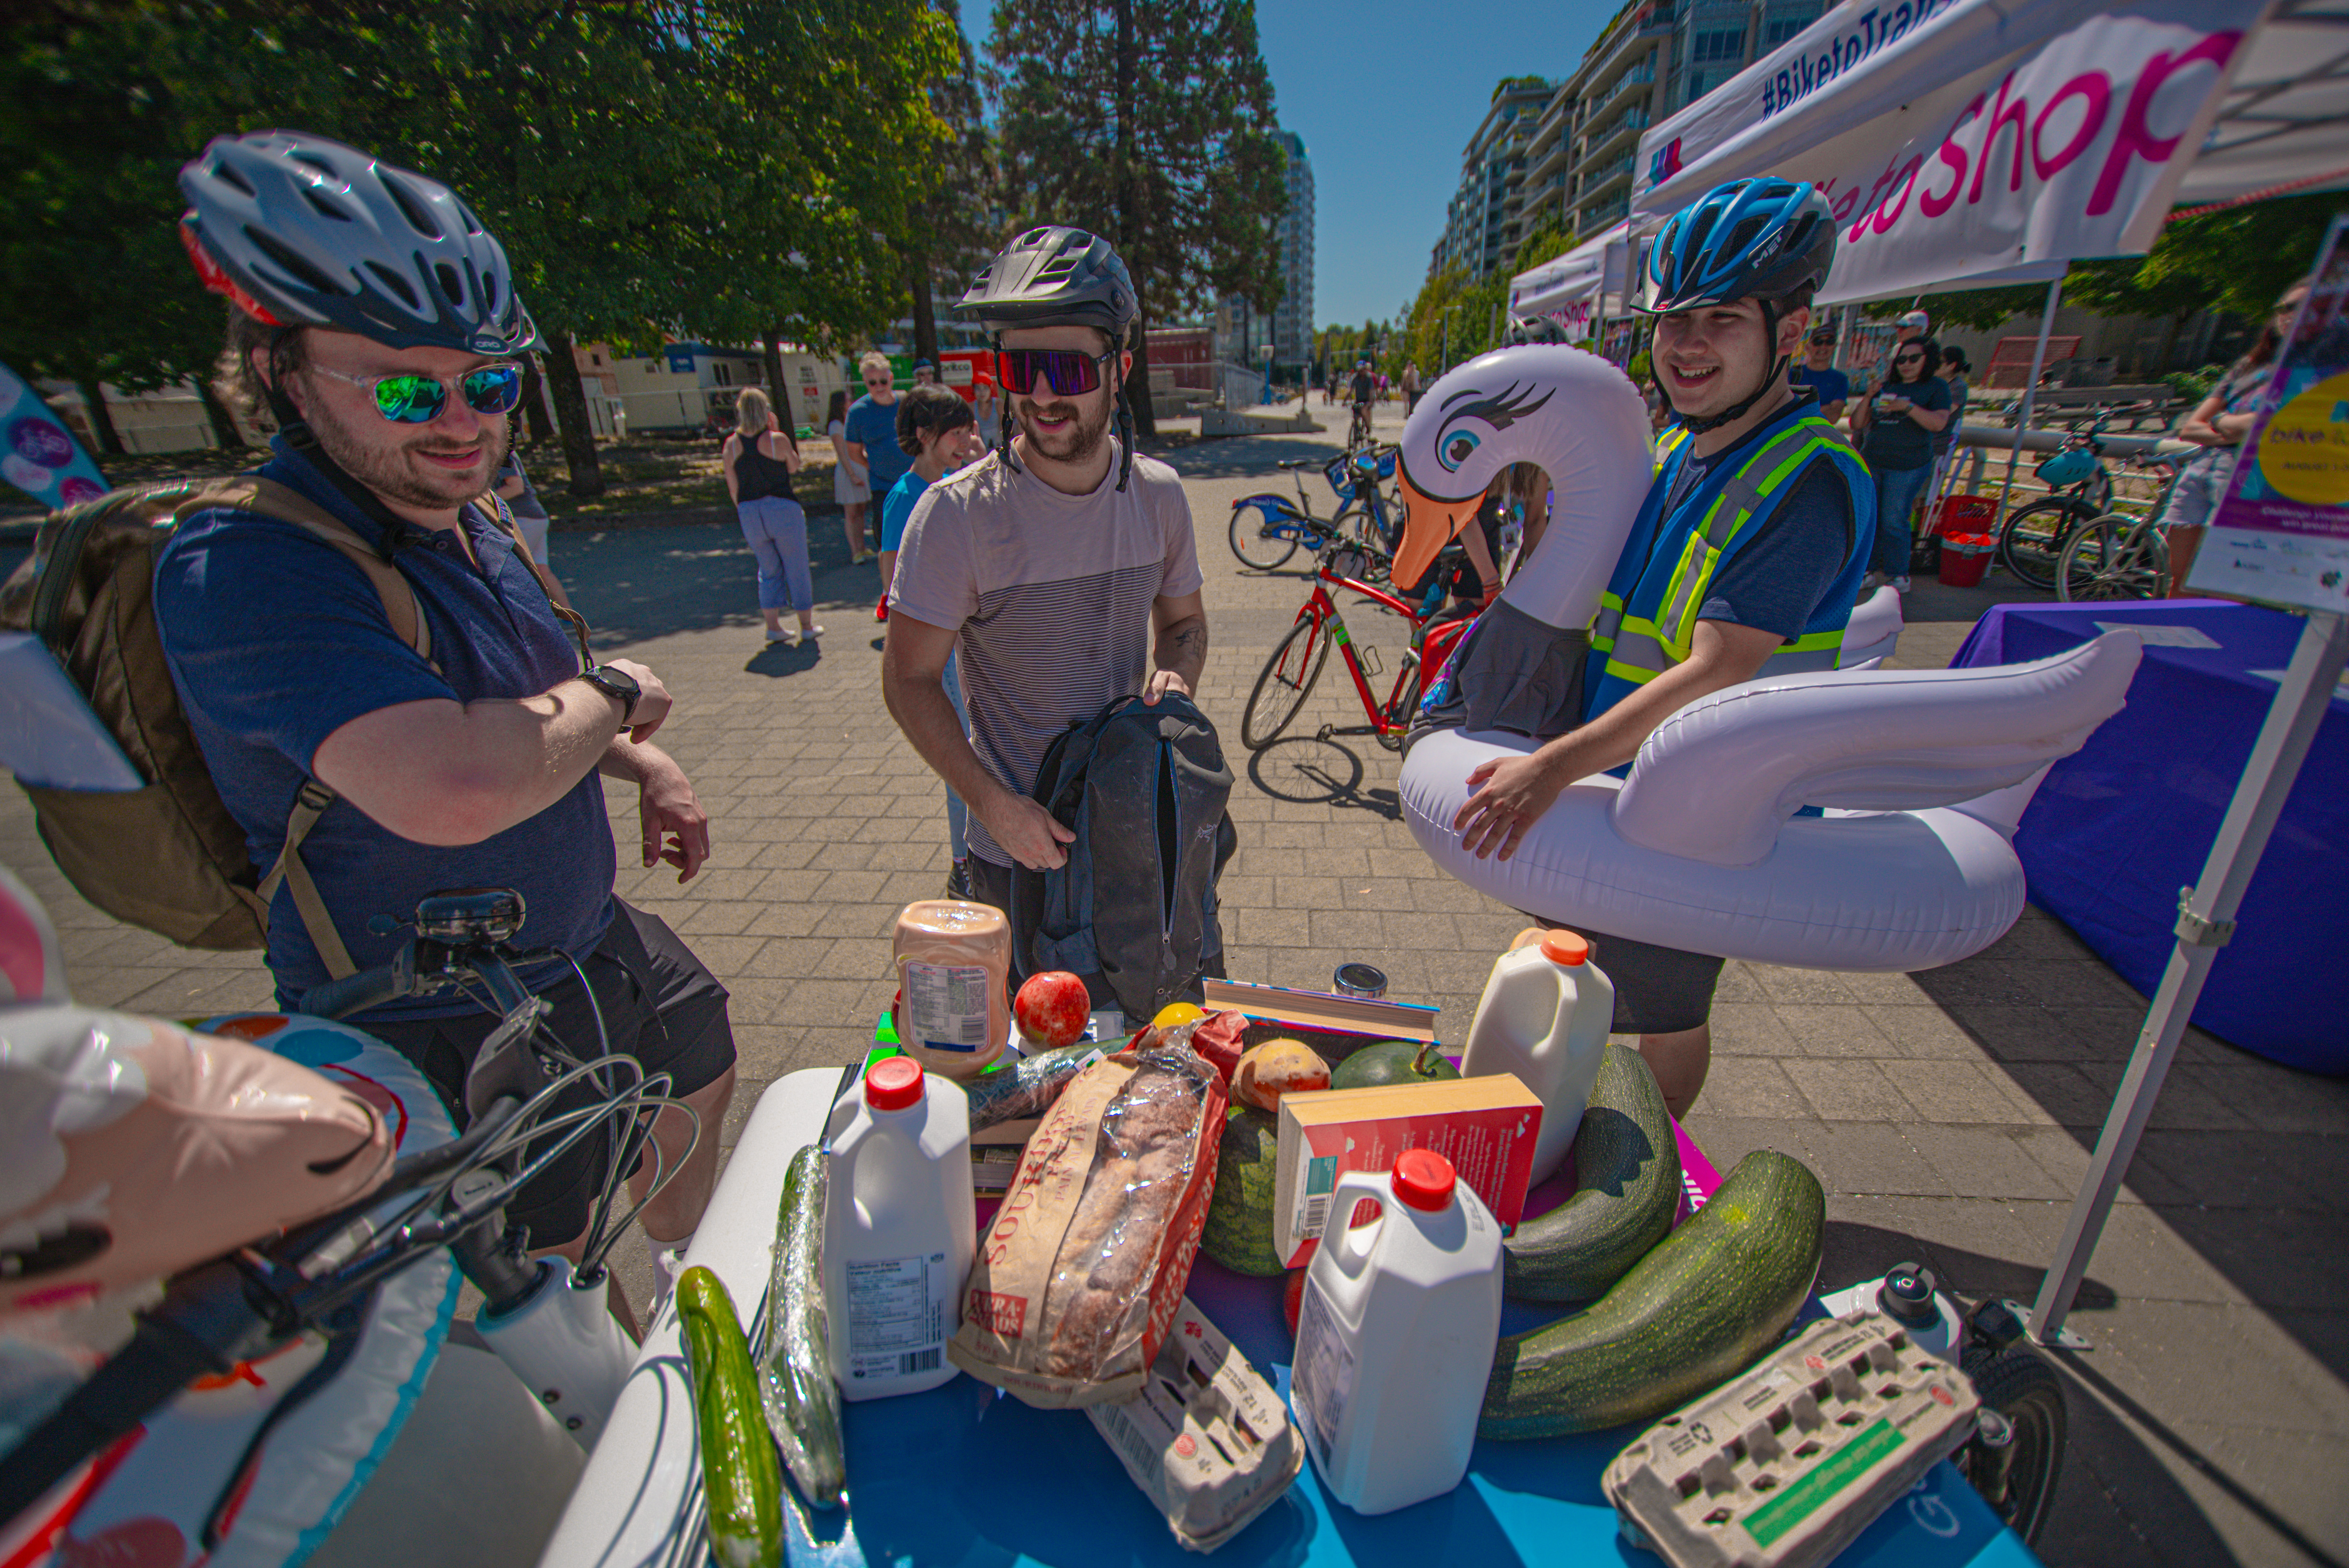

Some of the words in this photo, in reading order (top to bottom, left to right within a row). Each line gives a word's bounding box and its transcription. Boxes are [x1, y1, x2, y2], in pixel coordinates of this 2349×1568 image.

[1752, 230, 1783, 269] MET
[1074, 1094, 1099, 1142] LEVAIN
[1068, 1145, 1084, 1164] AU
[1054, 1165, 1075, 1203] PAIN
[1242, 1394, 1258, 1411] 12
